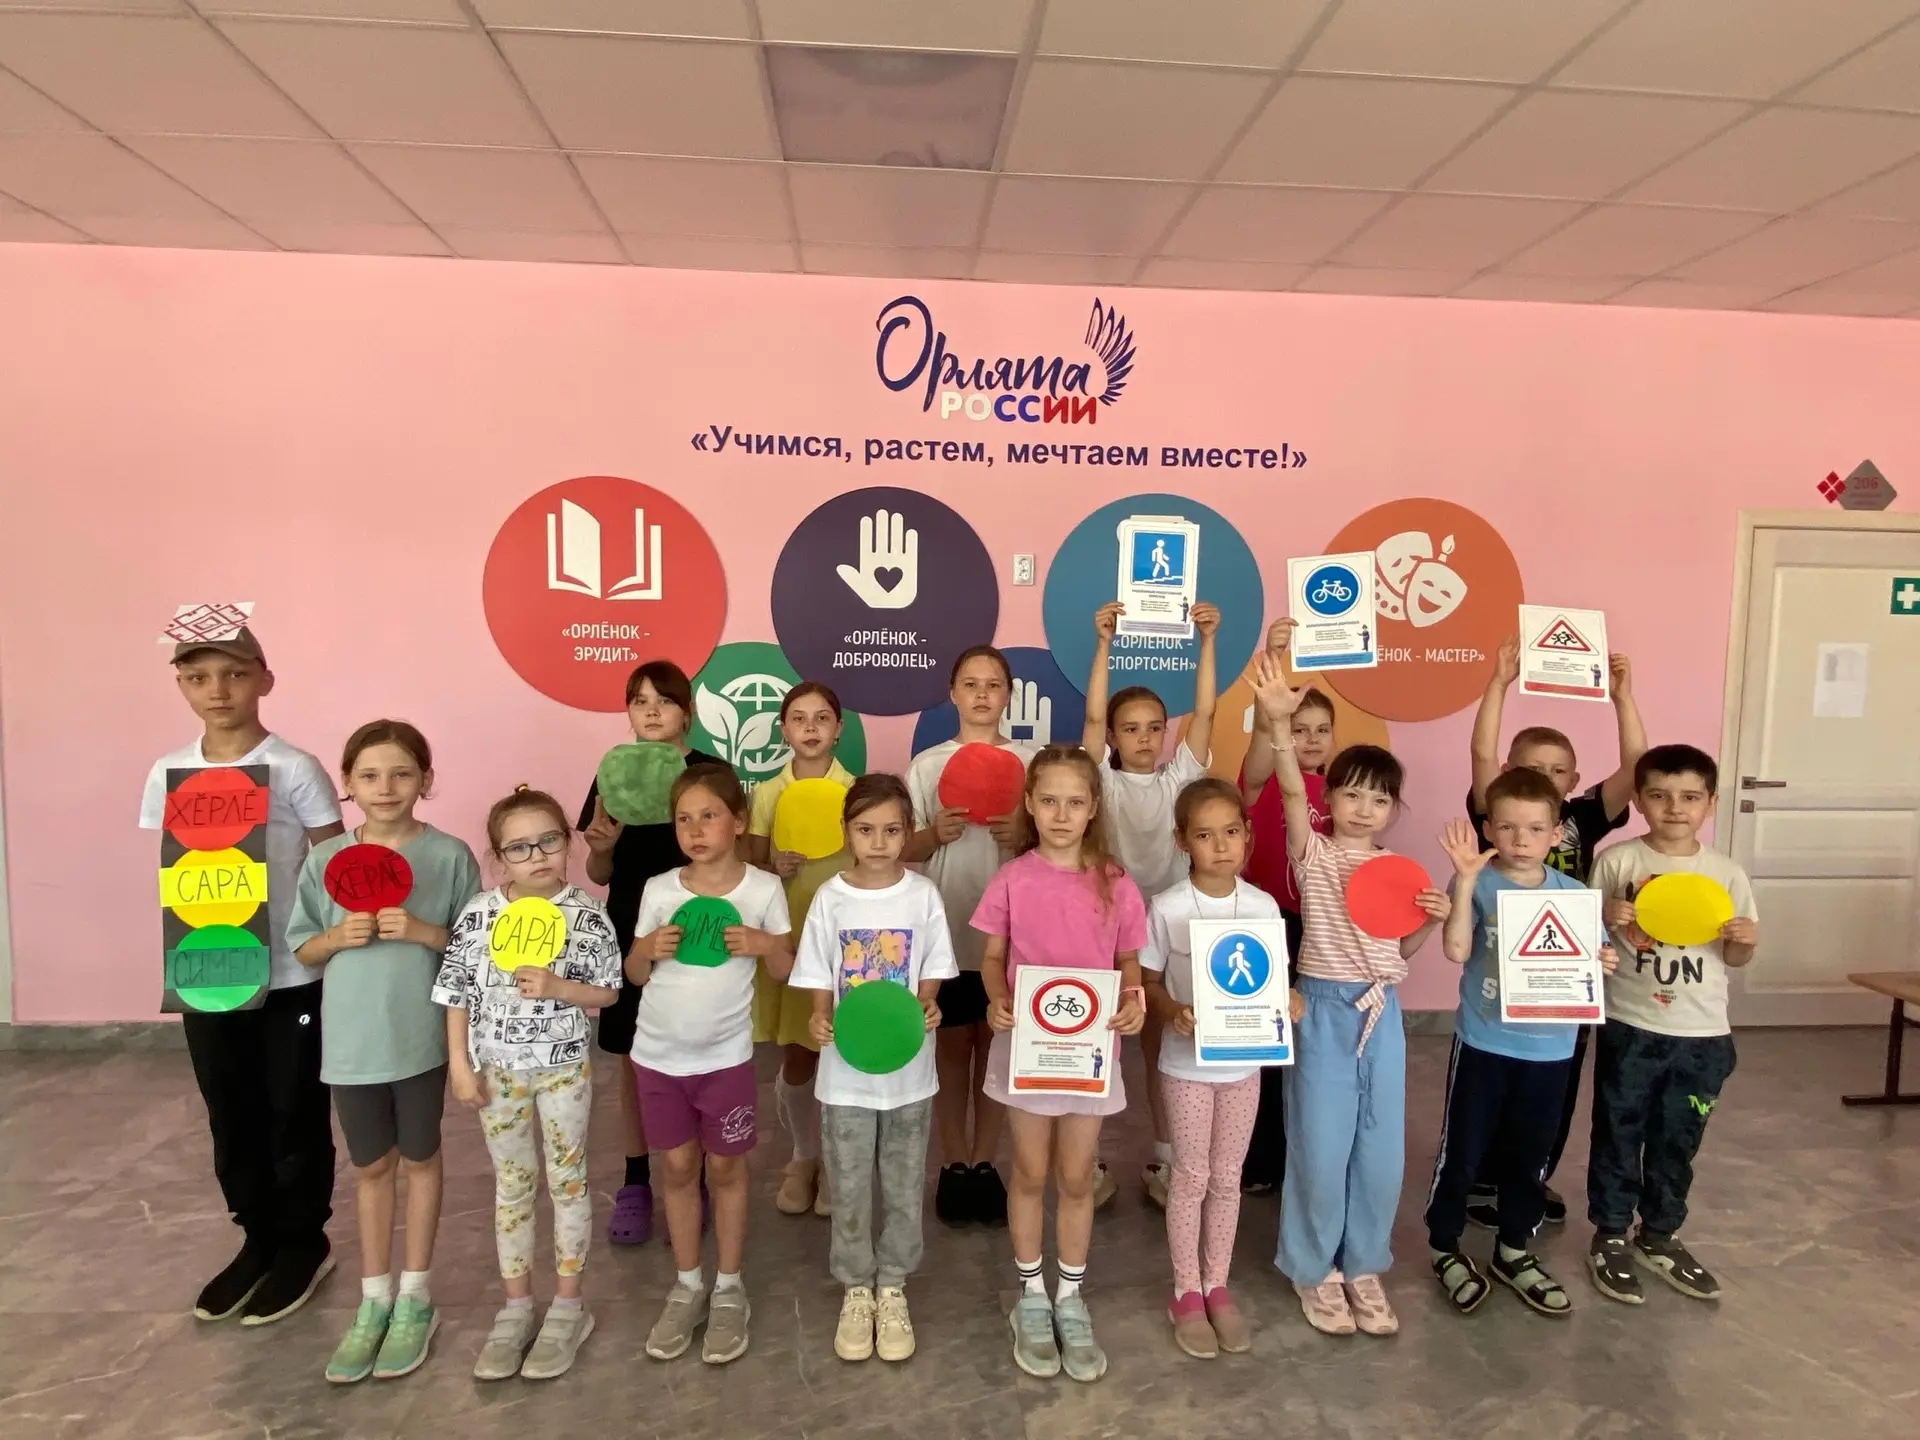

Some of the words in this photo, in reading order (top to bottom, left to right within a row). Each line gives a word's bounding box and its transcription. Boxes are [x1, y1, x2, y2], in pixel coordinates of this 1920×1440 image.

[875, 295, 1092, 412] Орлята
[940, 391, 1098, 425] РОССИИ
[691, 425, 852, 463] «Учимся,
[864, 437, 994, 468] растем,
[1007, 443, 1149, 467] мечтаем
[1160, 443, 1308, 469] вместе!»
[1853, 476, 1878, 490] 206
[561, 621, 641, 640] «ОРЛЁНОК
[843, 627, 918, 646] «ОРЛЁНОК
[573, 646, 639, 663] ЭРУДИТ»
[832, 652, 937, 670] ДОБРОВОЛЕЦ»
[1107, 656, 1197, 671] СПОРТСМЕН»
[1425, 648, 1486, 663] МАСТЕР»
[1635, 947, 1704, 986] FUN
